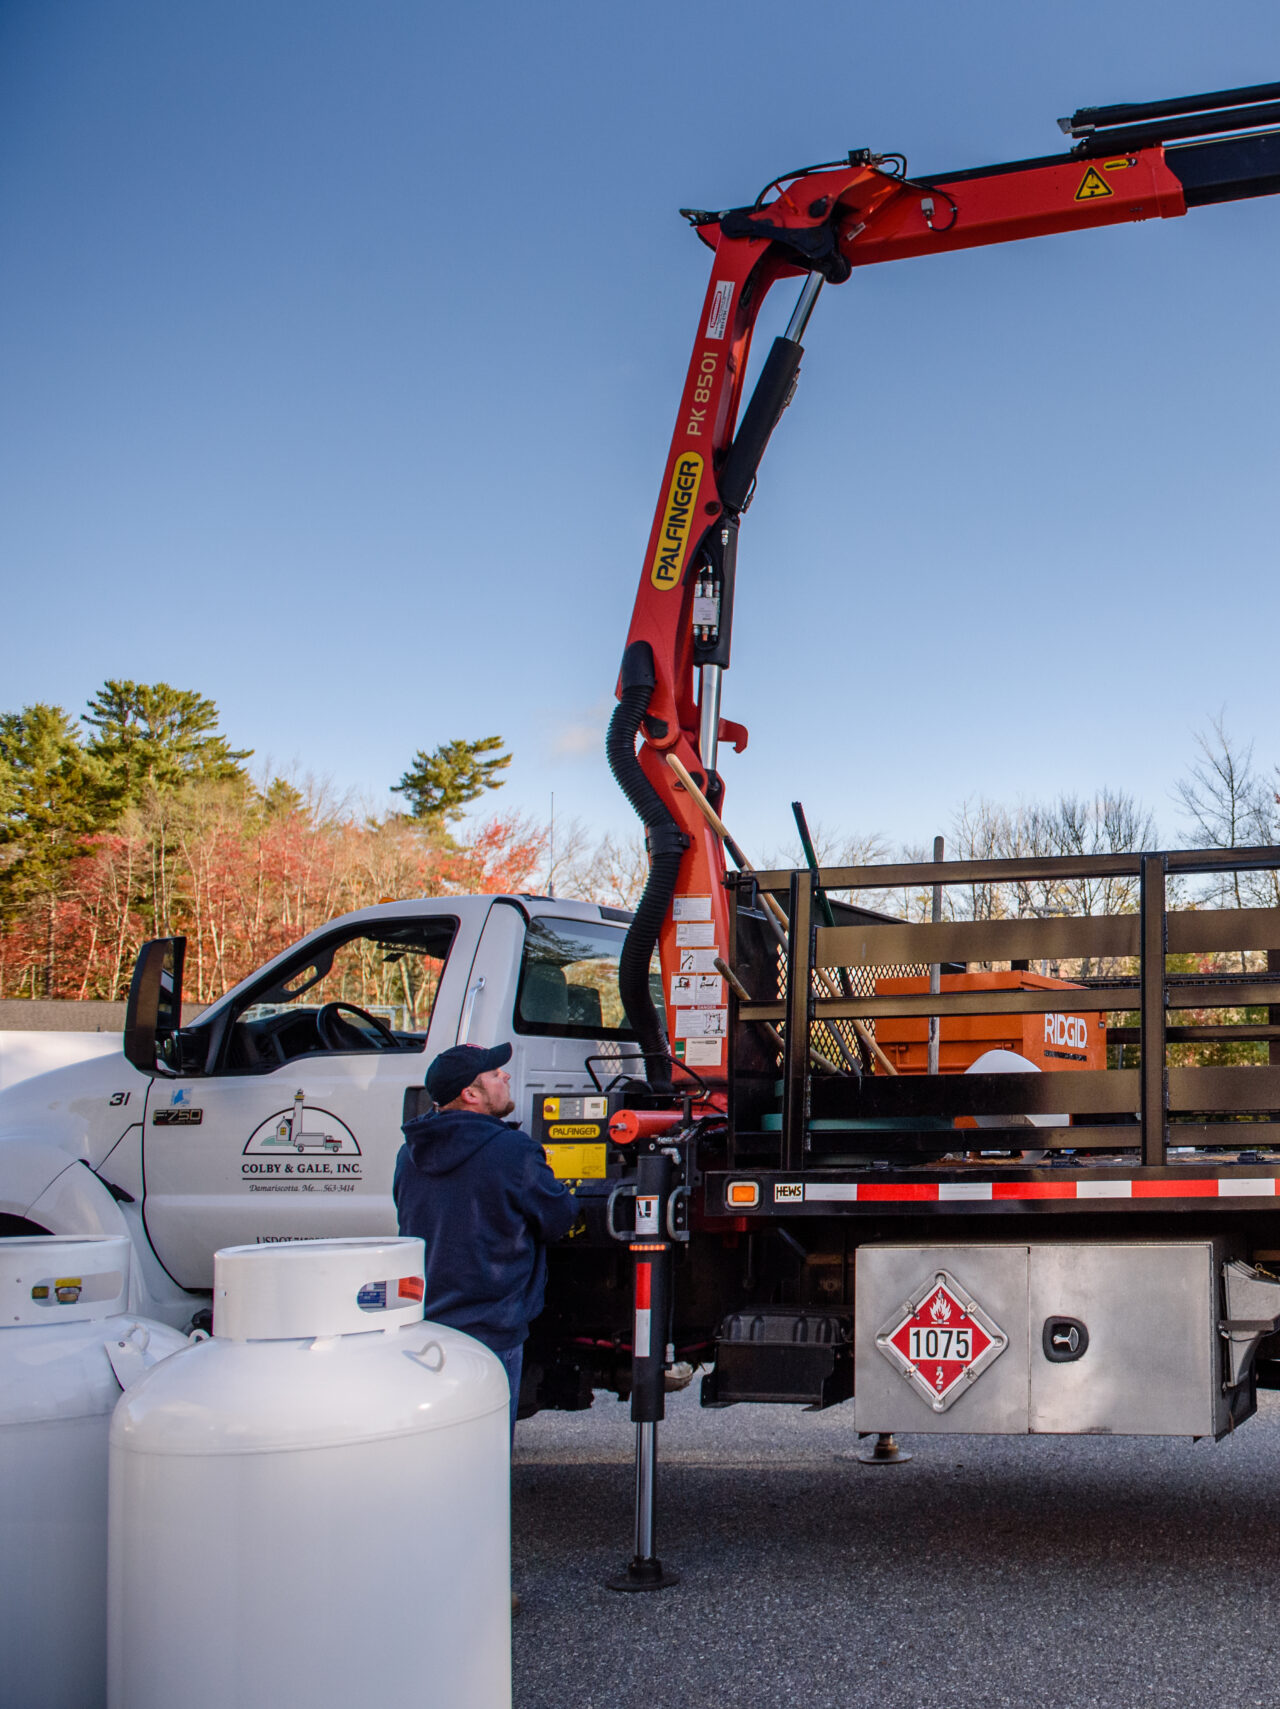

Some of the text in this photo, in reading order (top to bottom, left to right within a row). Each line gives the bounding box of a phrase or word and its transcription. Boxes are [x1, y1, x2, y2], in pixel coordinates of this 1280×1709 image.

[694, 351, 719, 403] 8501
[686, 407, 706, 436] PK
[655, 460, 699, 582] PALFINGER
[1044, 1013, 1088, 1048] RIDGID
[109, 1091, 131, 1106] 31
[552, 1127, 597, 1136] PALFINGER
[241, 1163, 362, 1174] COLBY & GALE, INC.
[776, 1185, 802, 1200] HEWS
[912, 1329, 969, 1358] 1075
[935, 1370, 944, 1384] 2
